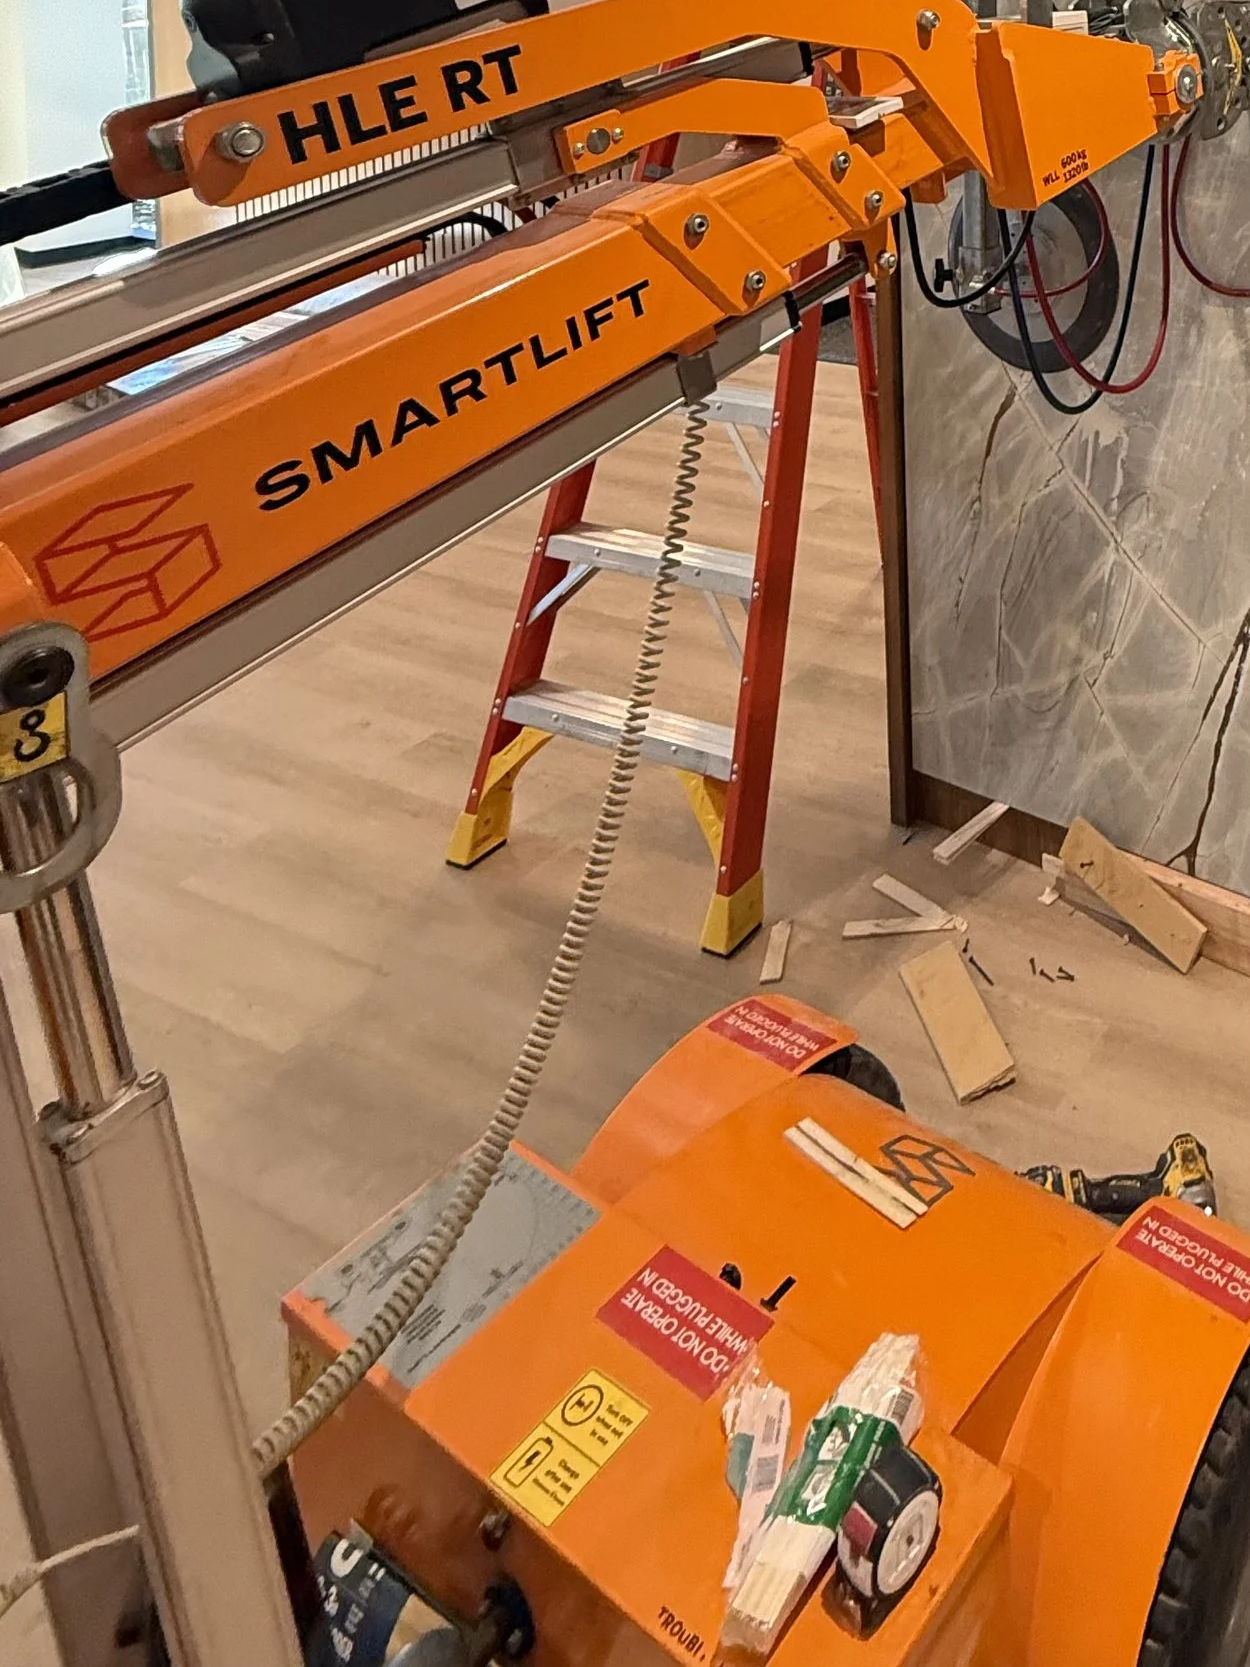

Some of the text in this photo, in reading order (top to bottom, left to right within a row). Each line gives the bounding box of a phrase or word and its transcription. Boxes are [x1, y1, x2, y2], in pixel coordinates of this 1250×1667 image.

[277, 44, 523, 165] HLE RT
[1042, 170, 1060, 187] WLL
[255, 279, 650, 512] SMARTLIFT
[724, 1014, 807, 1059] DO NOT OPERATE
[746, 1012, 794, 1038] PLUGGED
[789, 1033, 819, 1051] WHILE
[1142, 1216, 1160, 1230] IN
[1135, 1228, 1196, 1268] OPERATE
[1158, 1226, 1224, 1267] PLUGGED
[1194, 1264, 1228, 1288] NOT
[620, 1288, 729, 1374] DO NOT OPERATE
[637, 1267, 748, 1355] WHILE PLUGGED IN
